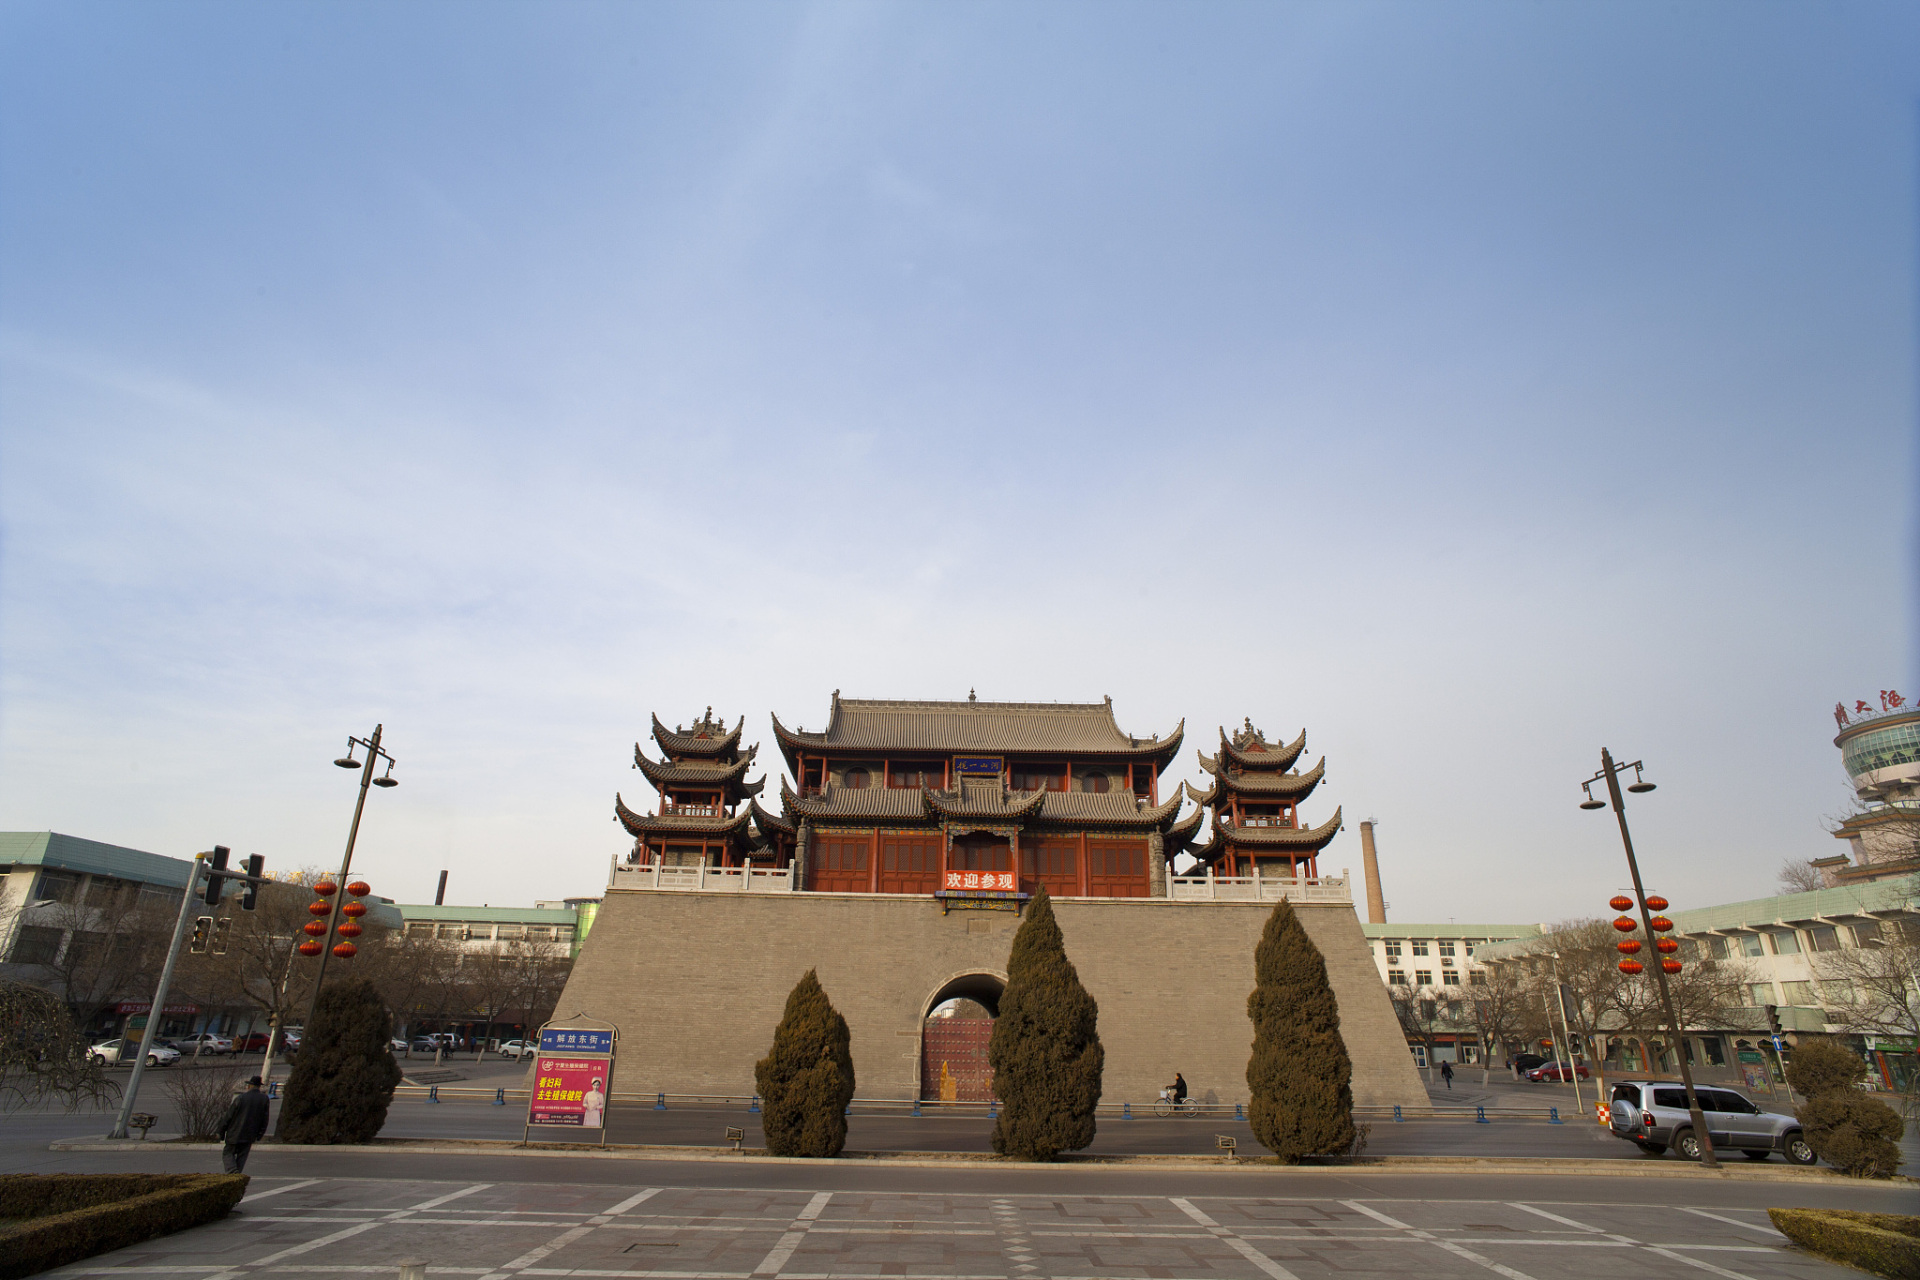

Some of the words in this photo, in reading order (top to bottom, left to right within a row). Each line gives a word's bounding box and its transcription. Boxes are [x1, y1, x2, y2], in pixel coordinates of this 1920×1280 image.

[947, 872, 1013, 888] 欢迎参观
[556, 1034, 598, 1044] 解放东街
[539, 1077, 562, 1088] 看妇科
[537, 1089, 583, 1101] 去生殖保健院
